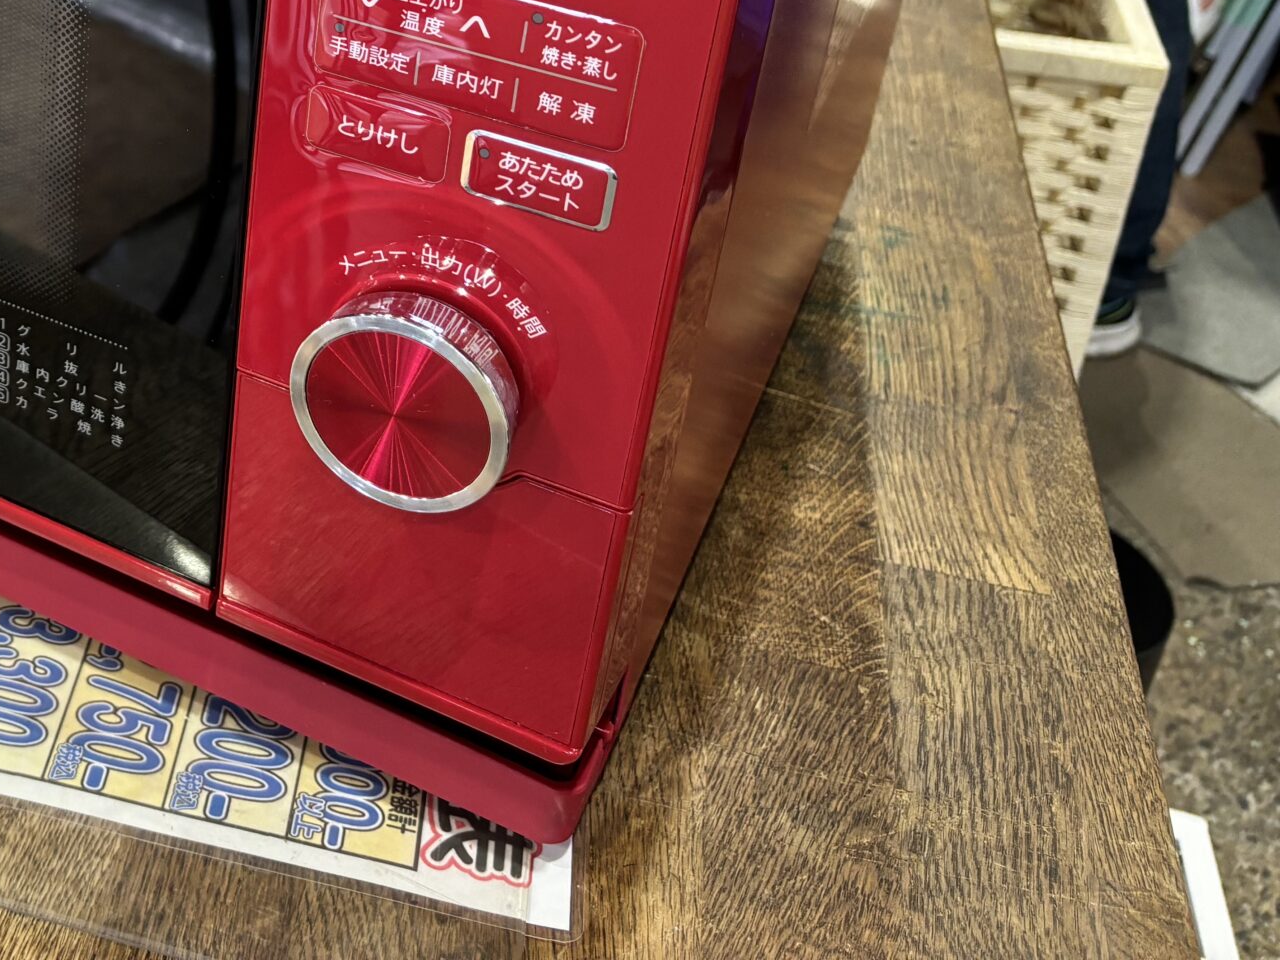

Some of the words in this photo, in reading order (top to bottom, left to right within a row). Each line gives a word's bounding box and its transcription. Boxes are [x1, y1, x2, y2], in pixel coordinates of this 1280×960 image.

[400, 9, 445, 38] 温度
[544, 20, 623, 54] カンタン
[328, 36, 410, 75] 手動設定
[541, 45, 618, 81] 焼き・蒸し
[431, 65, 504, 100] 庫内灯
[537, 91, 596, 124] 解凍
[338, 115, 419, 155] とりけし
[495, 174, 580, 212] スタート
[499, 151, 584, 191] あたため
[16, 342, 127, 394] 水抜き
[17, 324, 127, 375] グリル
[16, 358, 126, 410] 庫内クリーン
[16, 377, 125, 430] クエン酸洗浄
[16, 395, 124, 447] カラ焼き
[67, 638, 185, 794] ,750-
[48, 741, 90, 784] 税込
[169, 768, 209, 815] 税込
[385, 776, 420, 836] 金額計
[290, 793, 331, 839] 以上
[427, 798, 535, 887] 表
